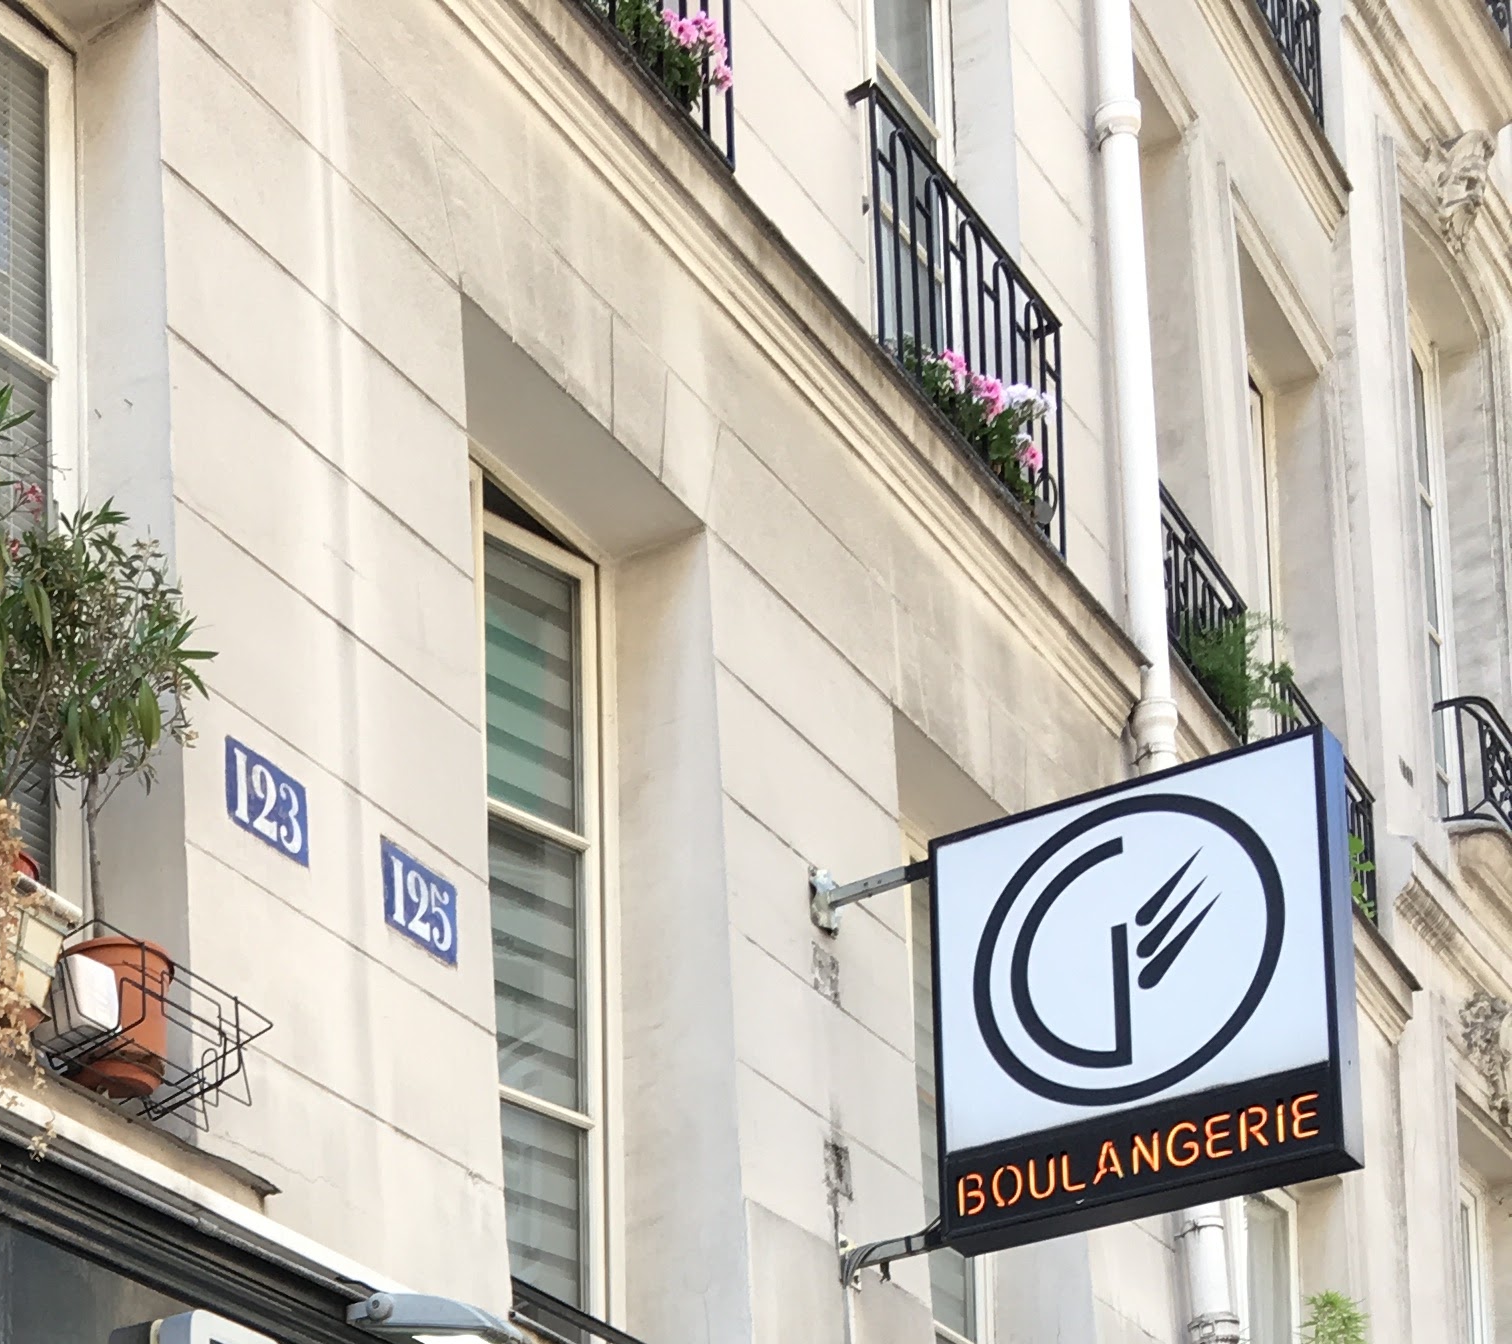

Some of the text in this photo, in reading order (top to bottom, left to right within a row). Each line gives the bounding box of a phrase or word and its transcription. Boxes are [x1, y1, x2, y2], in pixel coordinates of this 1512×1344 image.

[233, 747, 302, 854] 123
[390, 856, 453, 951] 125
[957, 1092, 1320, 1217] BOULANGERIE
